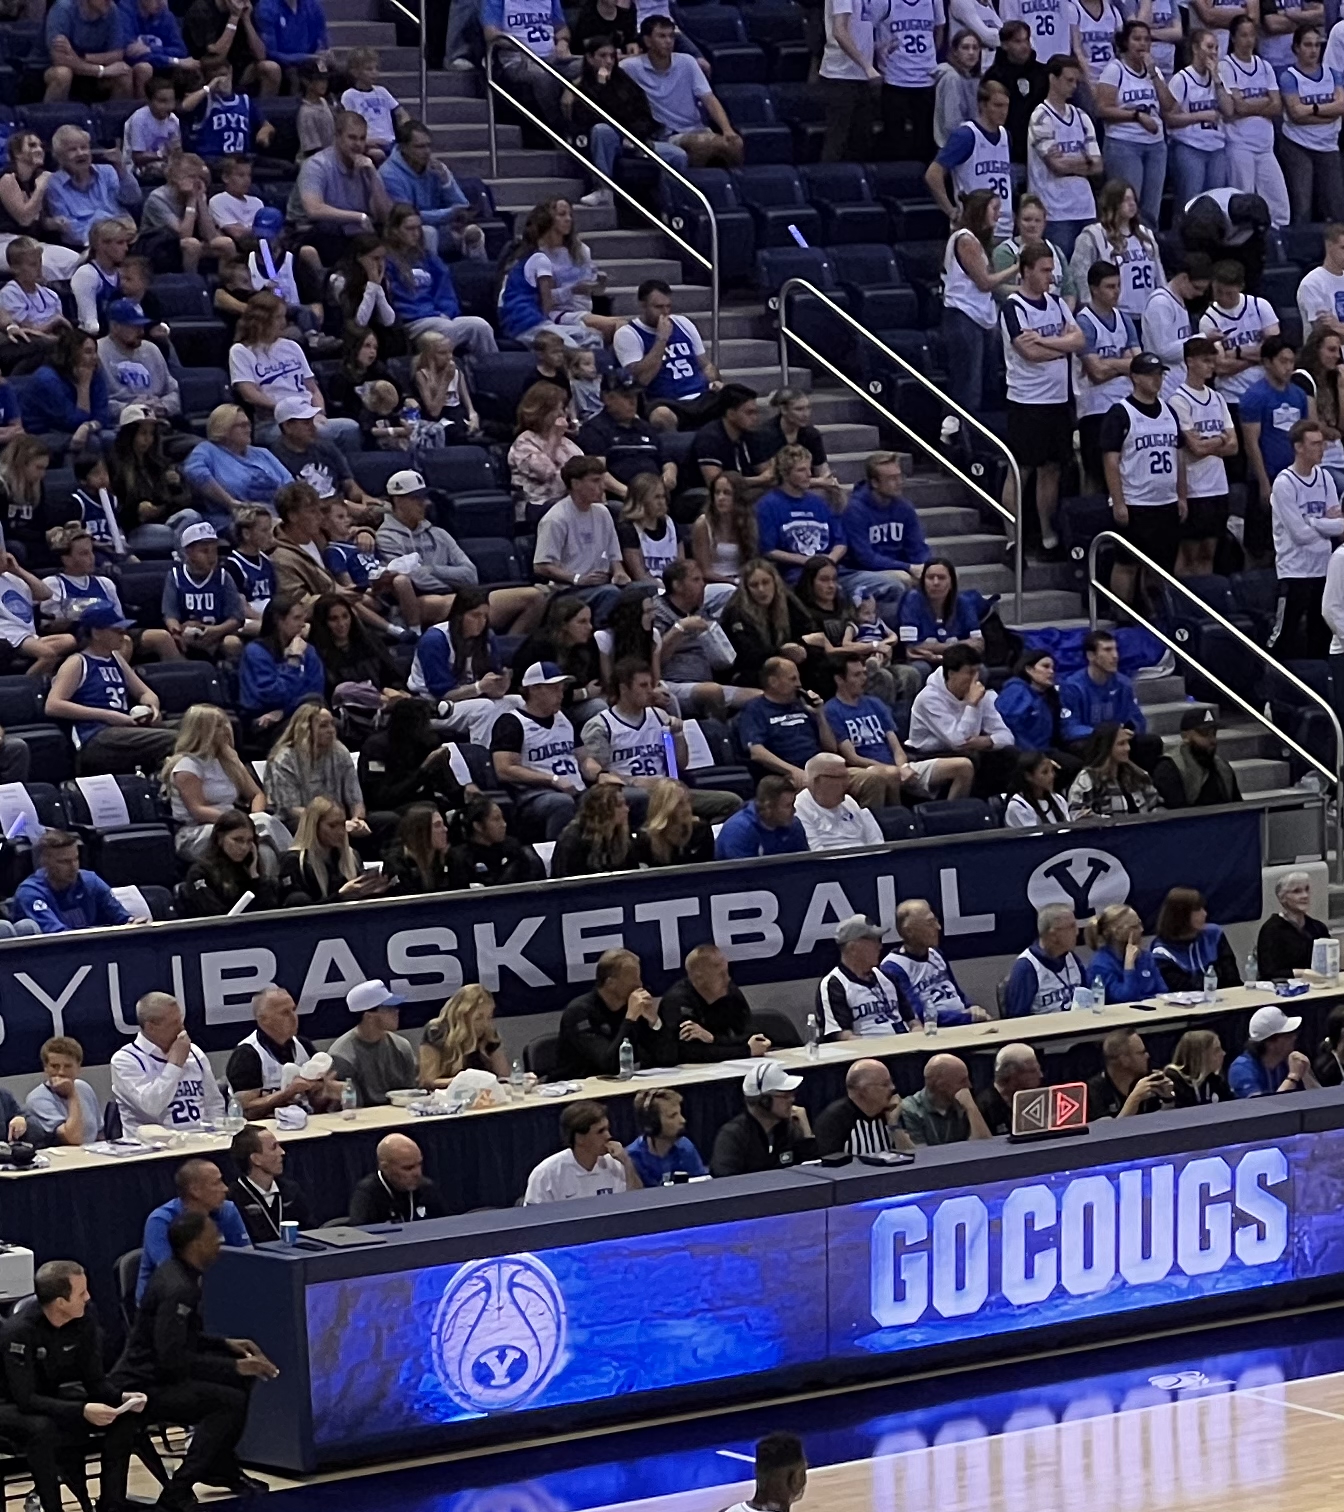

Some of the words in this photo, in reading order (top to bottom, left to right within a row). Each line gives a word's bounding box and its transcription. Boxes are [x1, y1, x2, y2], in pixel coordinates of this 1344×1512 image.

[1035, 16, 1055, 36] 26
[1150, 452, 1172, 473] 26
[869, 524, 904, 543] BYU
[185, 592, 214, 609] BYU
[167, 1099, 201, 1124] 26
[870, 1194, 989, 1328] GO
[1001, 1147, 1291, 1306] COUGS
